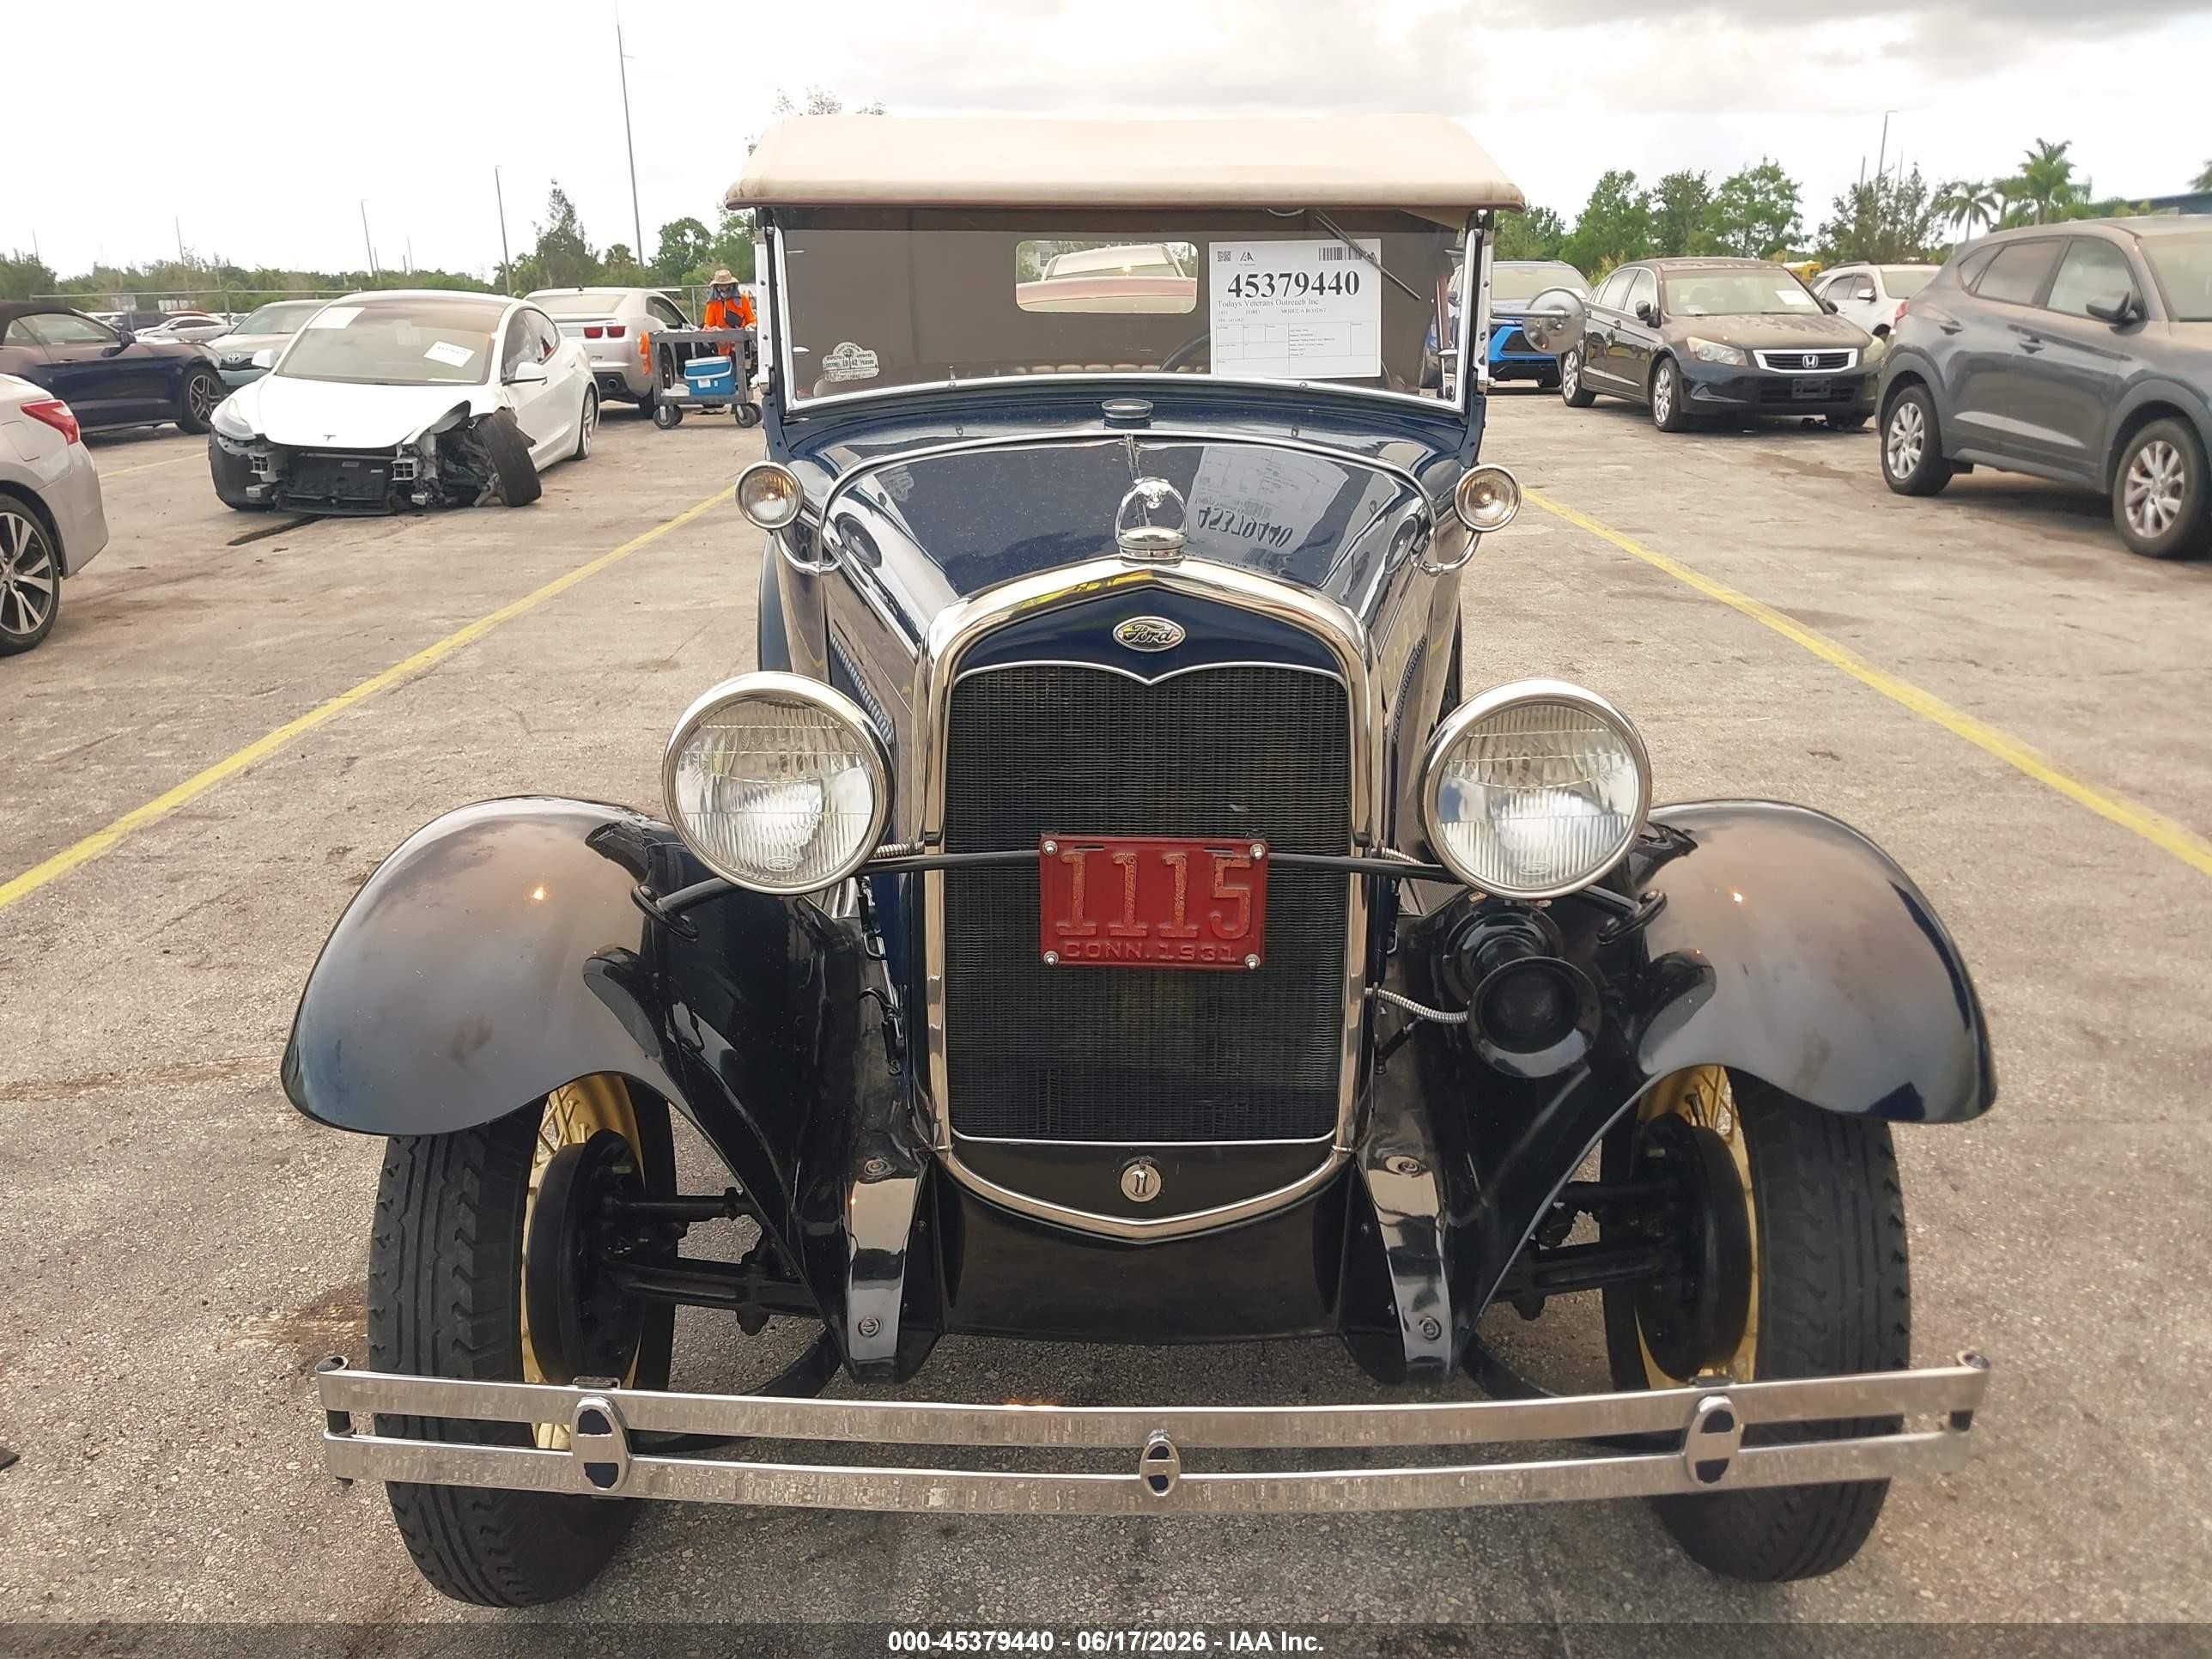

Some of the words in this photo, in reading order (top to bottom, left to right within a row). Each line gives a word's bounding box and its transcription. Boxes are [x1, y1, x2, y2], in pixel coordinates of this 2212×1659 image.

[1228, 270, 1359, 298] 45379440
[1218, 300, 1243, 308] Todays
[1276, 297, 1306, 307] Outreach
[1122, 622, 1174, 644] Ford
[1056, 852, 1251, 939] 1115
